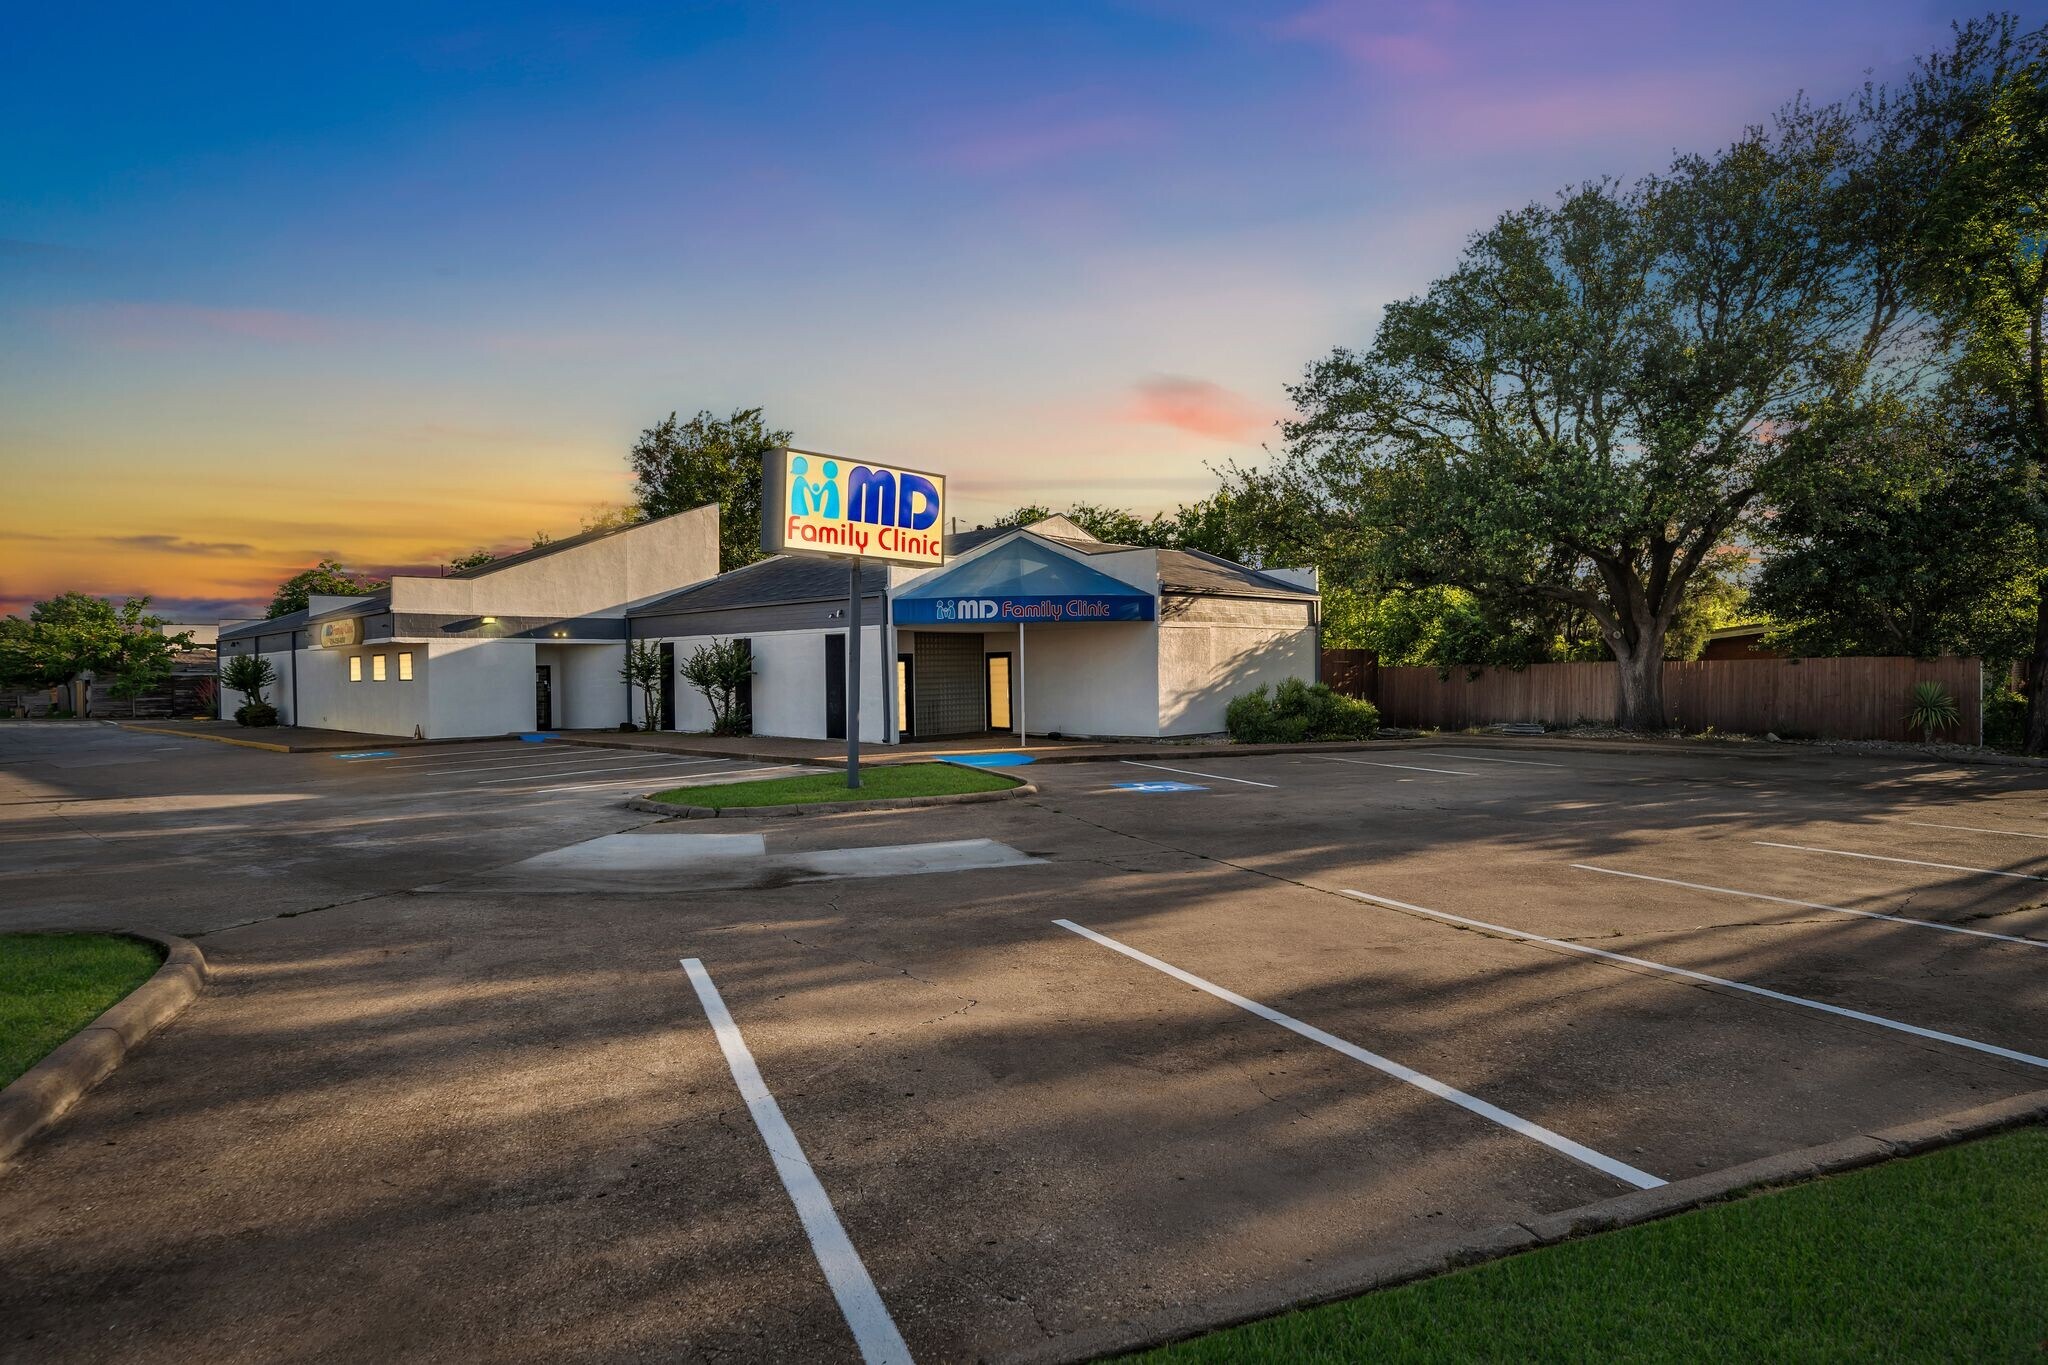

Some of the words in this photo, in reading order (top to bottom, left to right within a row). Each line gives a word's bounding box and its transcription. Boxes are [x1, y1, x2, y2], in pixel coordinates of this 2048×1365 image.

[848, 465, 940, 531] MD
[787, 515, 869, 554] Family
[878, 527, 940, 556] Clinic
[957, 599, 998, 619] MD
[1002, 599, 1062, 621] Family
[1065, 599, 1110, 617] Clinic
